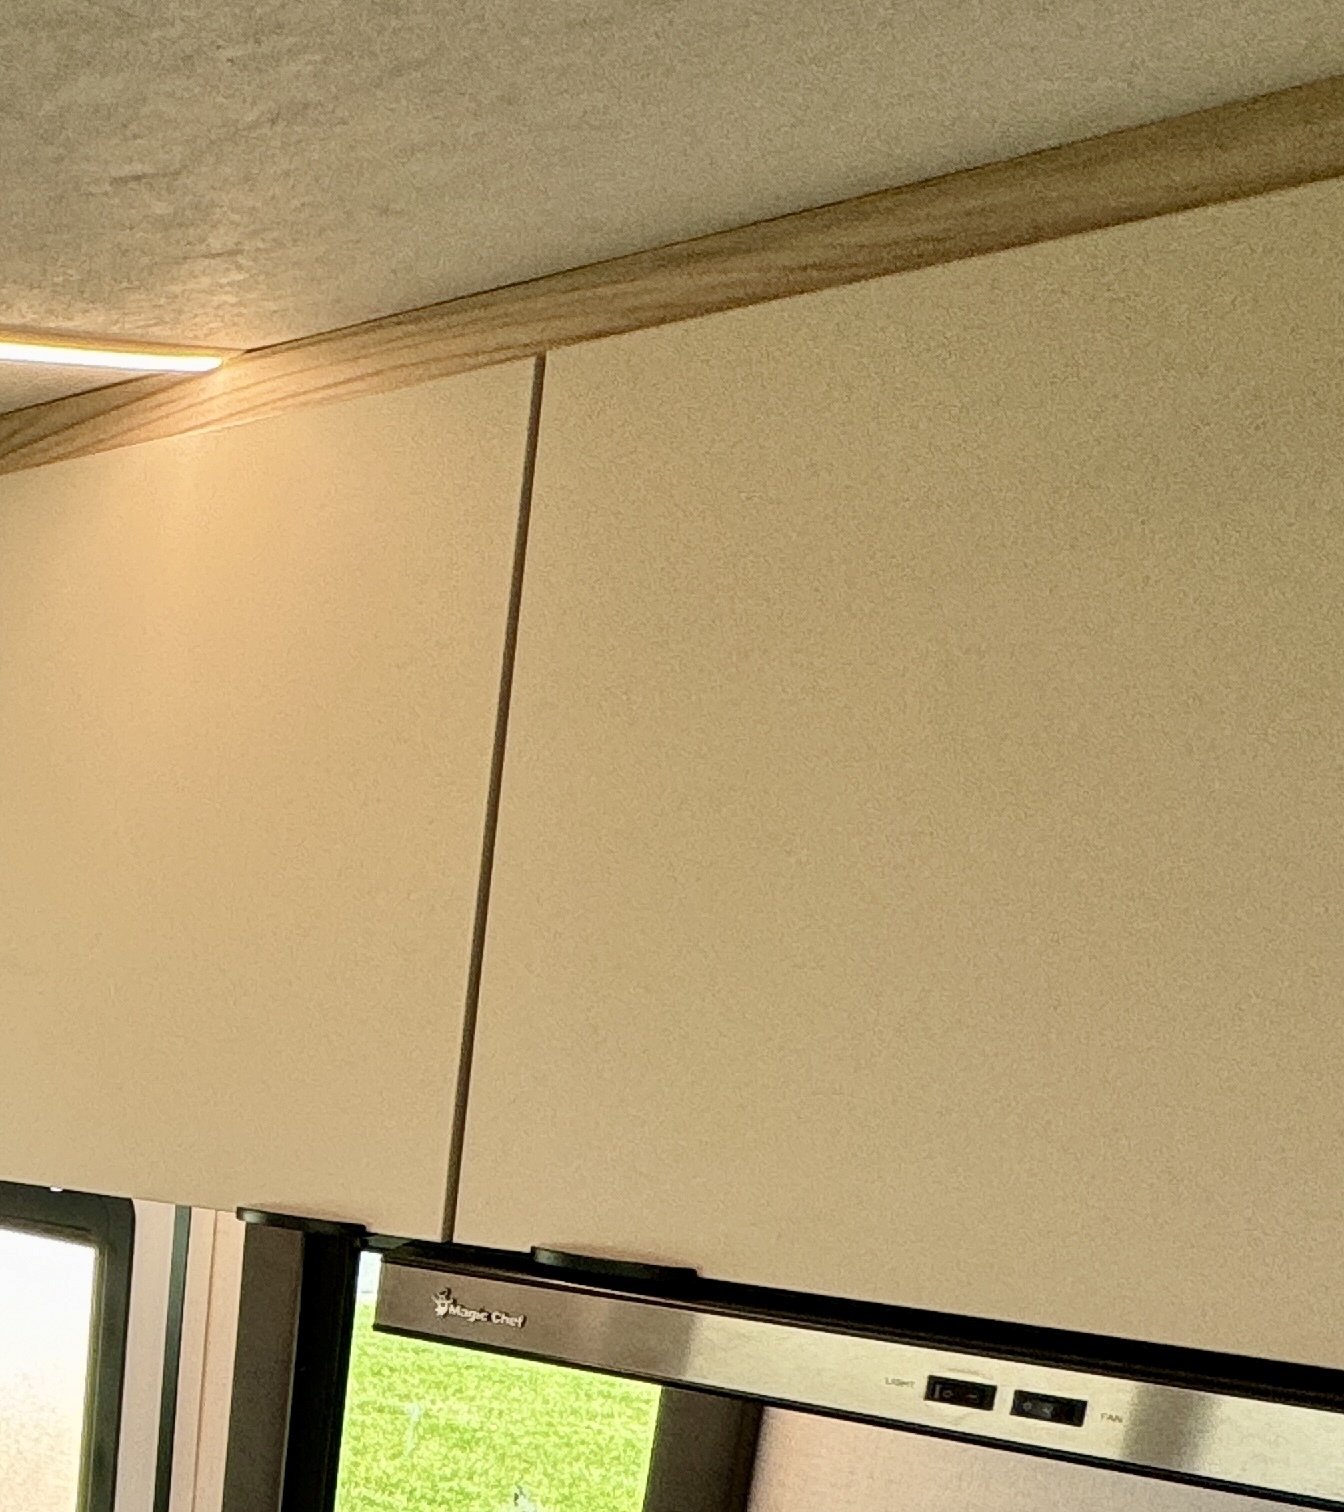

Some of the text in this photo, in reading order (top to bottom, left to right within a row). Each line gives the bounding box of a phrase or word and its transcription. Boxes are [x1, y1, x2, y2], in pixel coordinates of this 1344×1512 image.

[448, 1304, 526, 1328] Magic Chef
[885, 1376, 916, 1388] LIGHT
[1100, 1412, 1123, 1424] FAN
